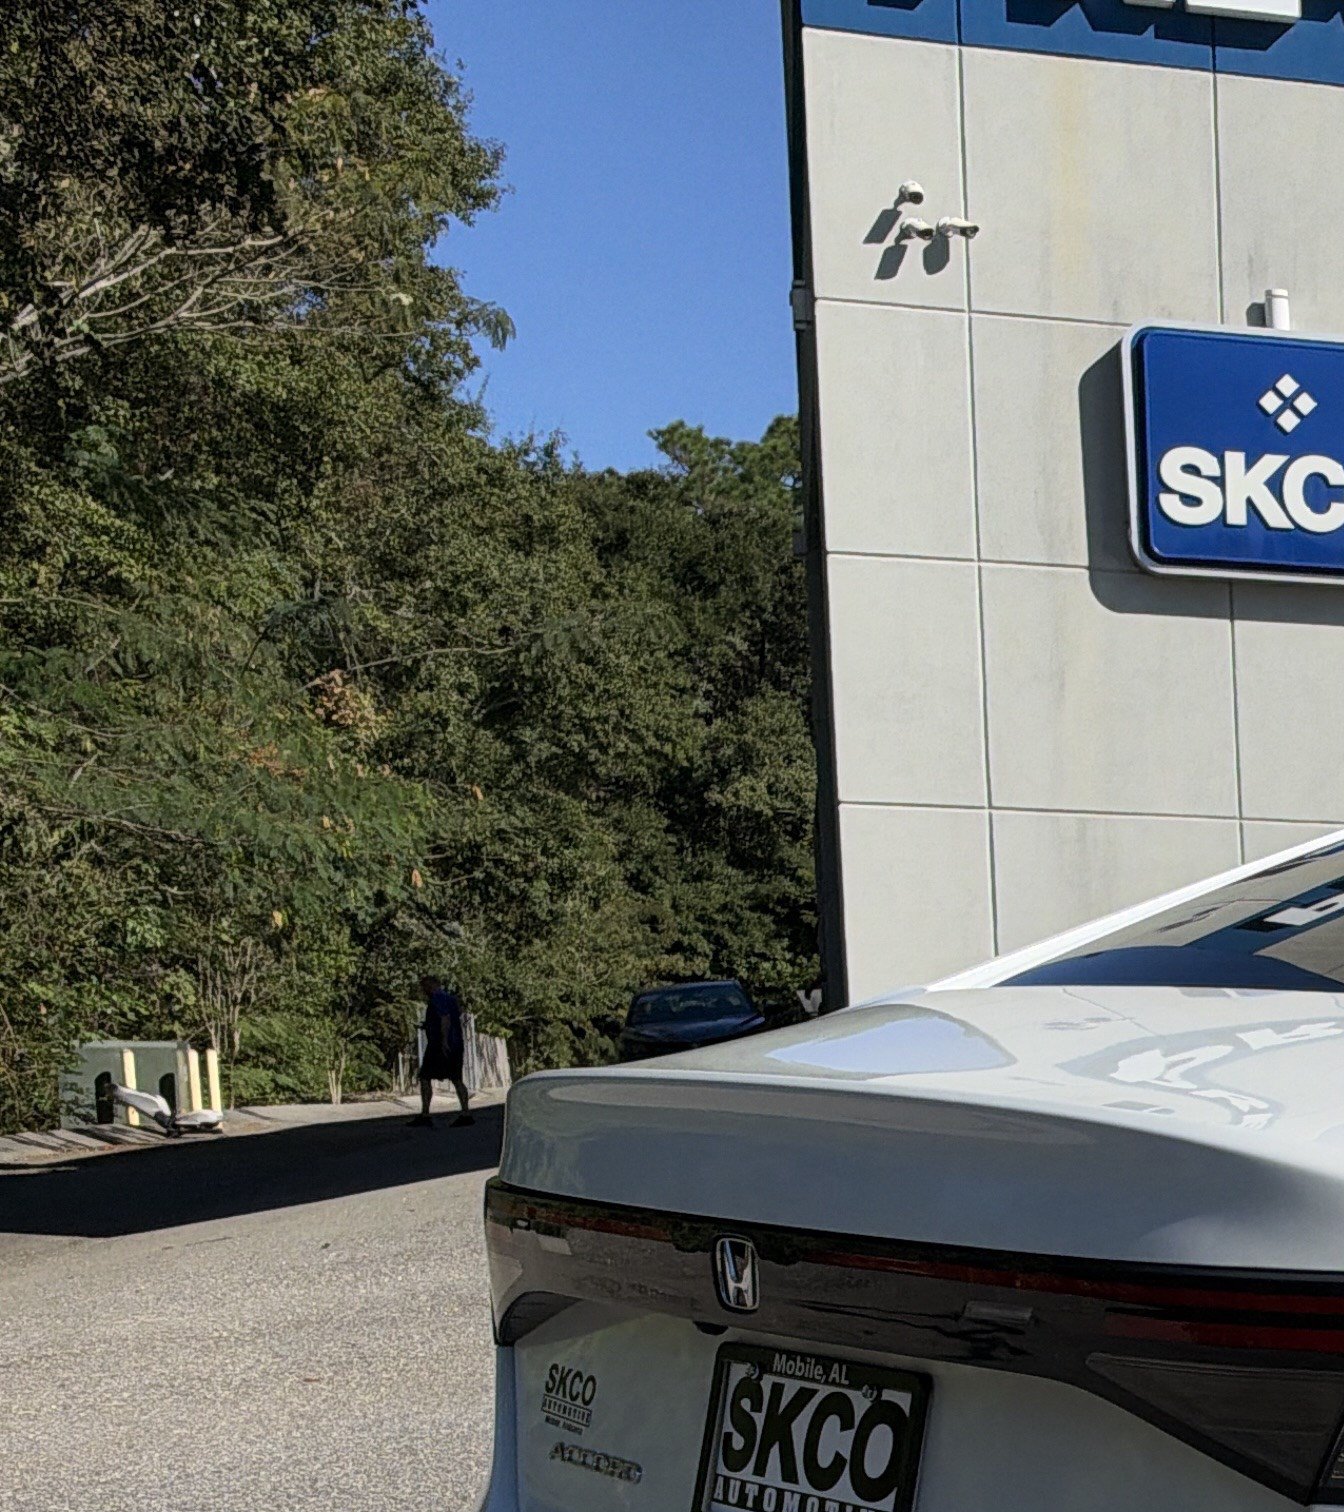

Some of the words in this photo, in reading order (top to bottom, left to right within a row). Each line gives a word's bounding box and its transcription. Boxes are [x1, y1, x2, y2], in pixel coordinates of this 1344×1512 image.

[544, 1362, 598, 1407] SKCO
[772, 1352, 827, 1384] Mobile,
[828, 1362, 850, 1385] AL
[721, 1375, 910, 1503] SKCO
